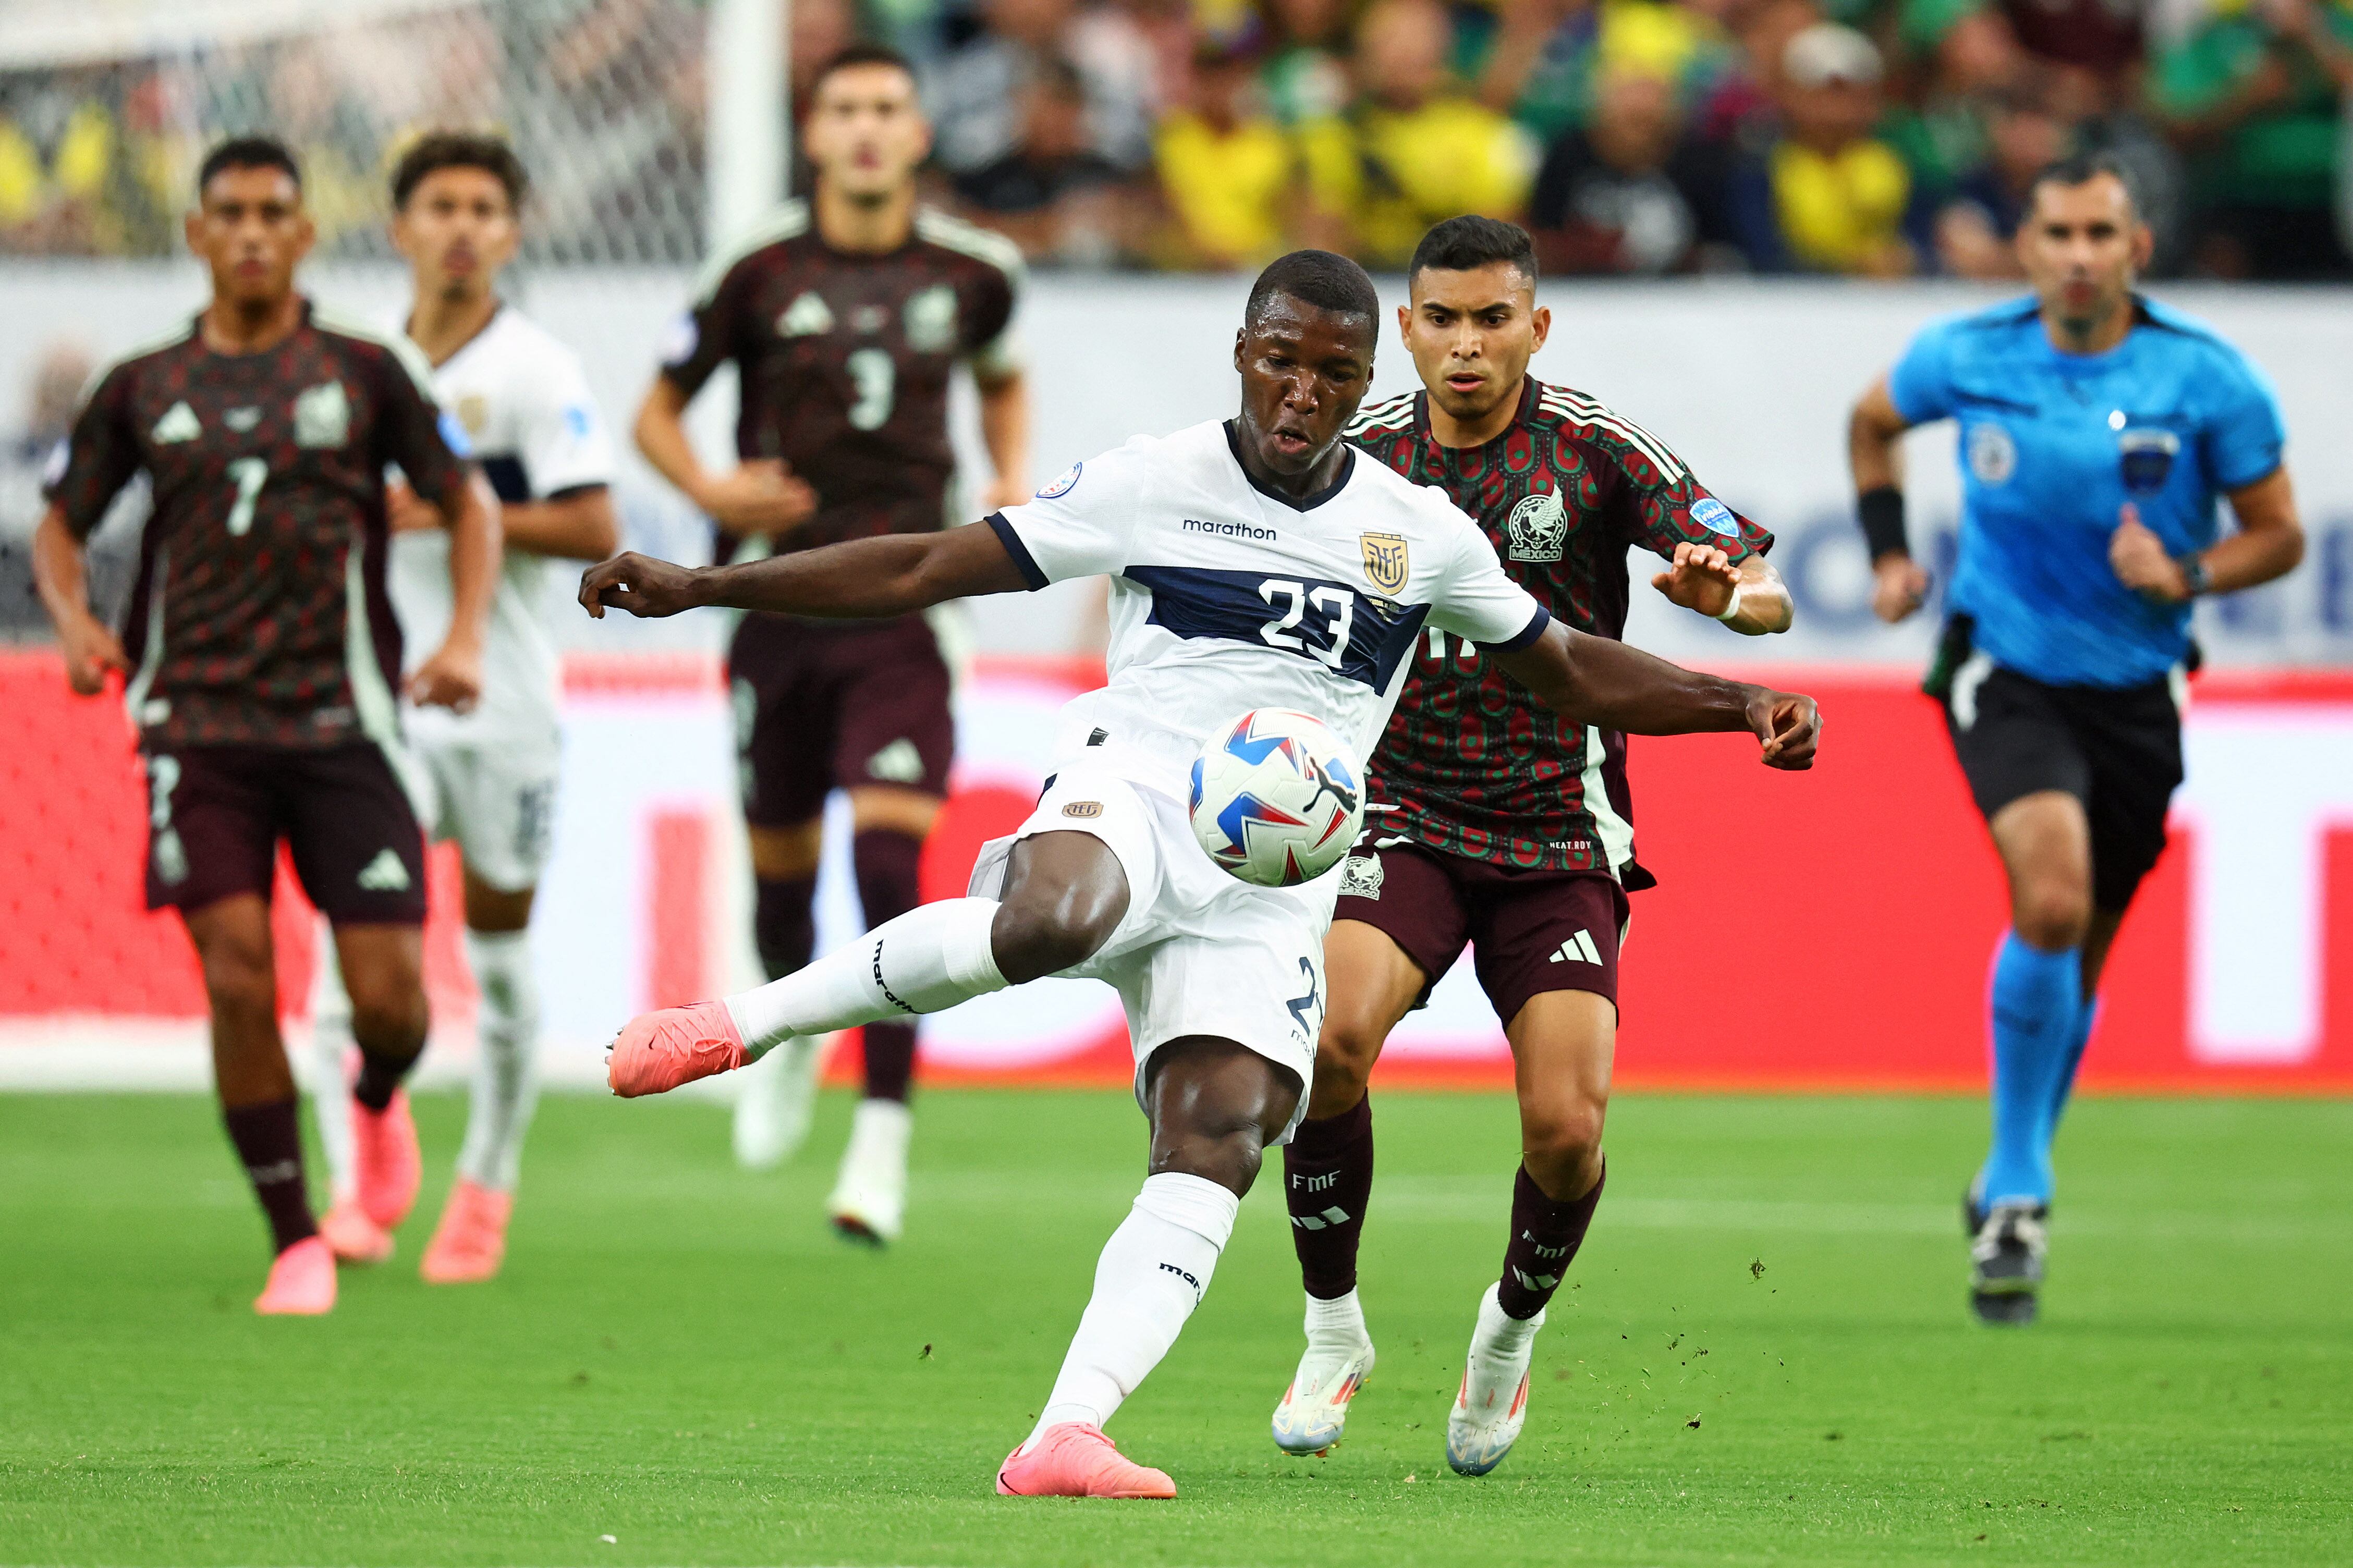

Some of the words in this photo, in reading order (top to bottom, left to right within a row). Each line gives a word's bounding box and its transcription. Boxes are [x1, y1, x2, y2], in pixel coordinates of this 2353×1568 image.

[845, 348, 896, 431] 3
[226, 457, 269, 536] 7
[1701, 506, 1726, 522] VIBRA
[1183, 519, 1277, 541] marathon
[1511, 546, 1559, 559] MÉXICO
[1258, 578, 1354, 669] 23
[1293, 1170, 1340, 1192] FMF
